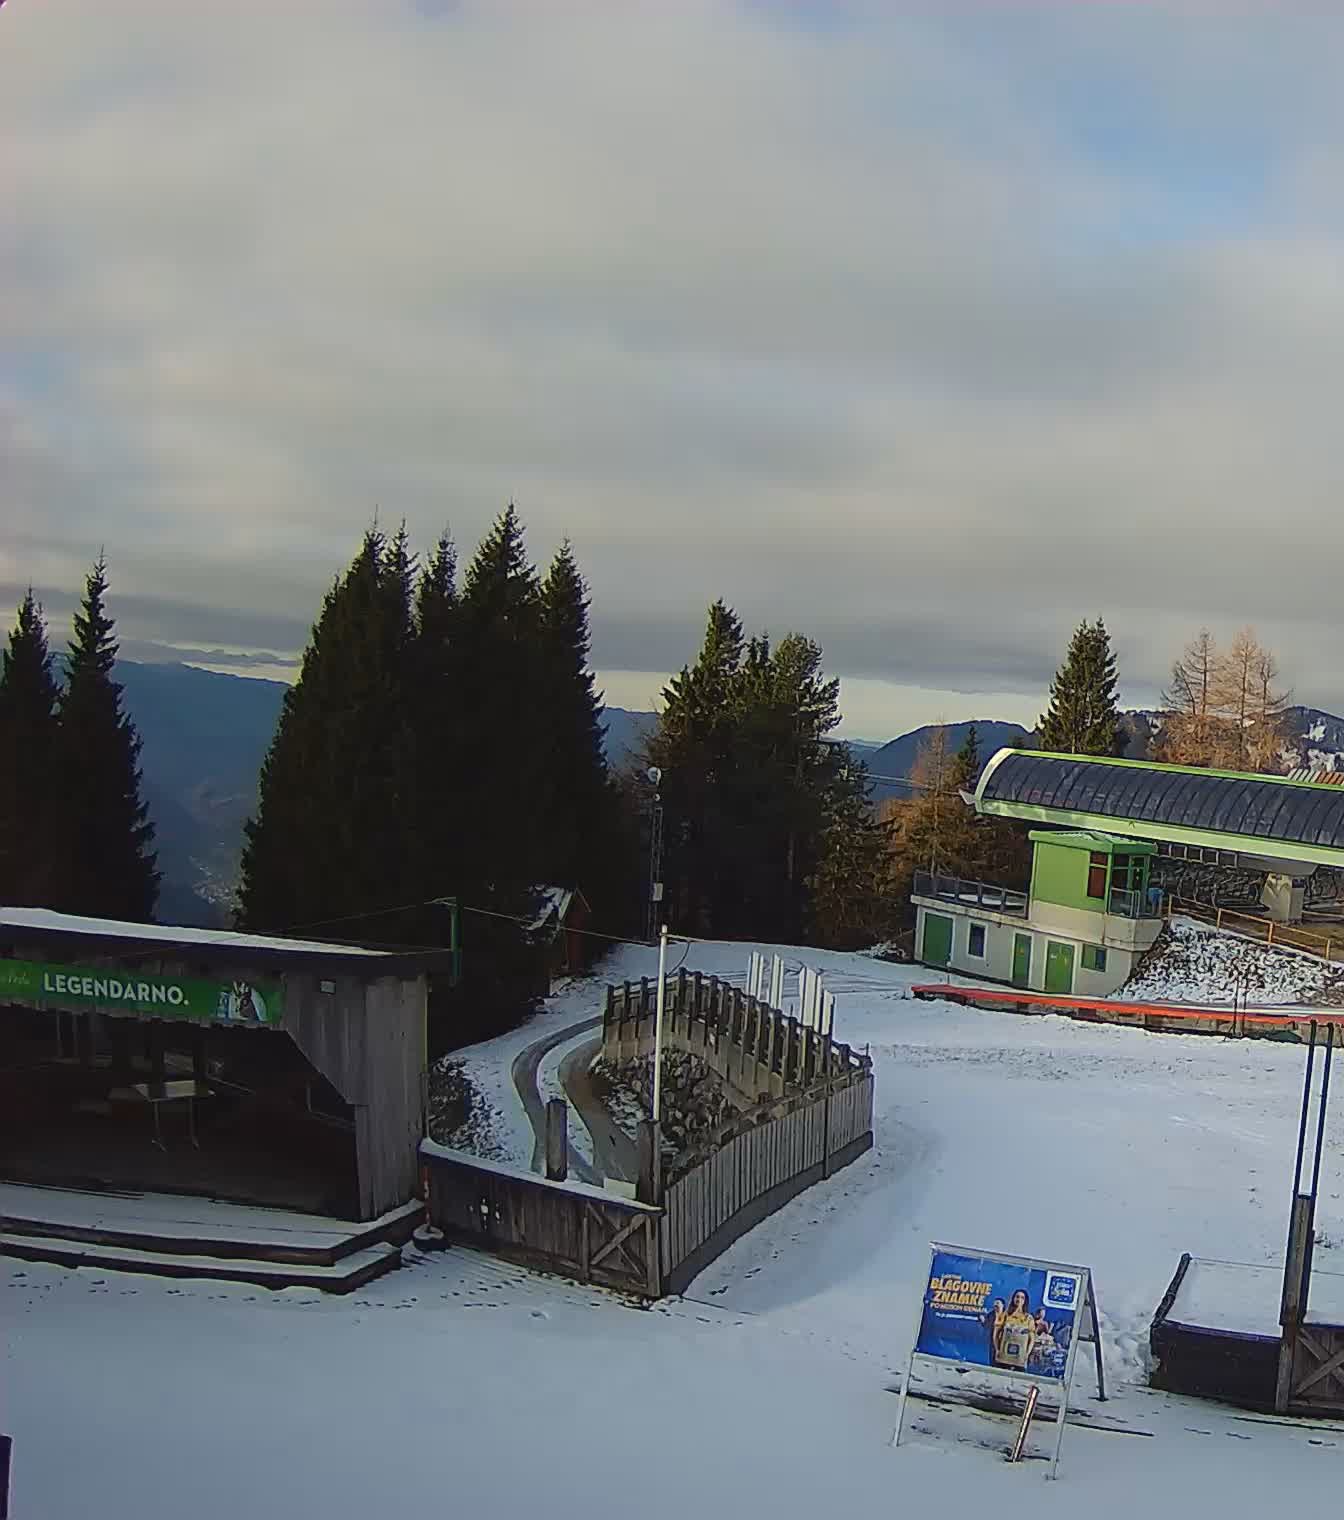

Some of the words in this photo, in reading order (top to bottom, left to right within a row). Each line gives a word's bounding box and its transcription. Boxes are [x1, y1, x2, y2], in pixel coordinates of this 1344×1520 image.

[43, 972, 190, 1006] LEGENDARNO.
[930, 1277, 993, 1297] BLAGOVNE
[932, 1290, 986, 1307] ZNAMKE
